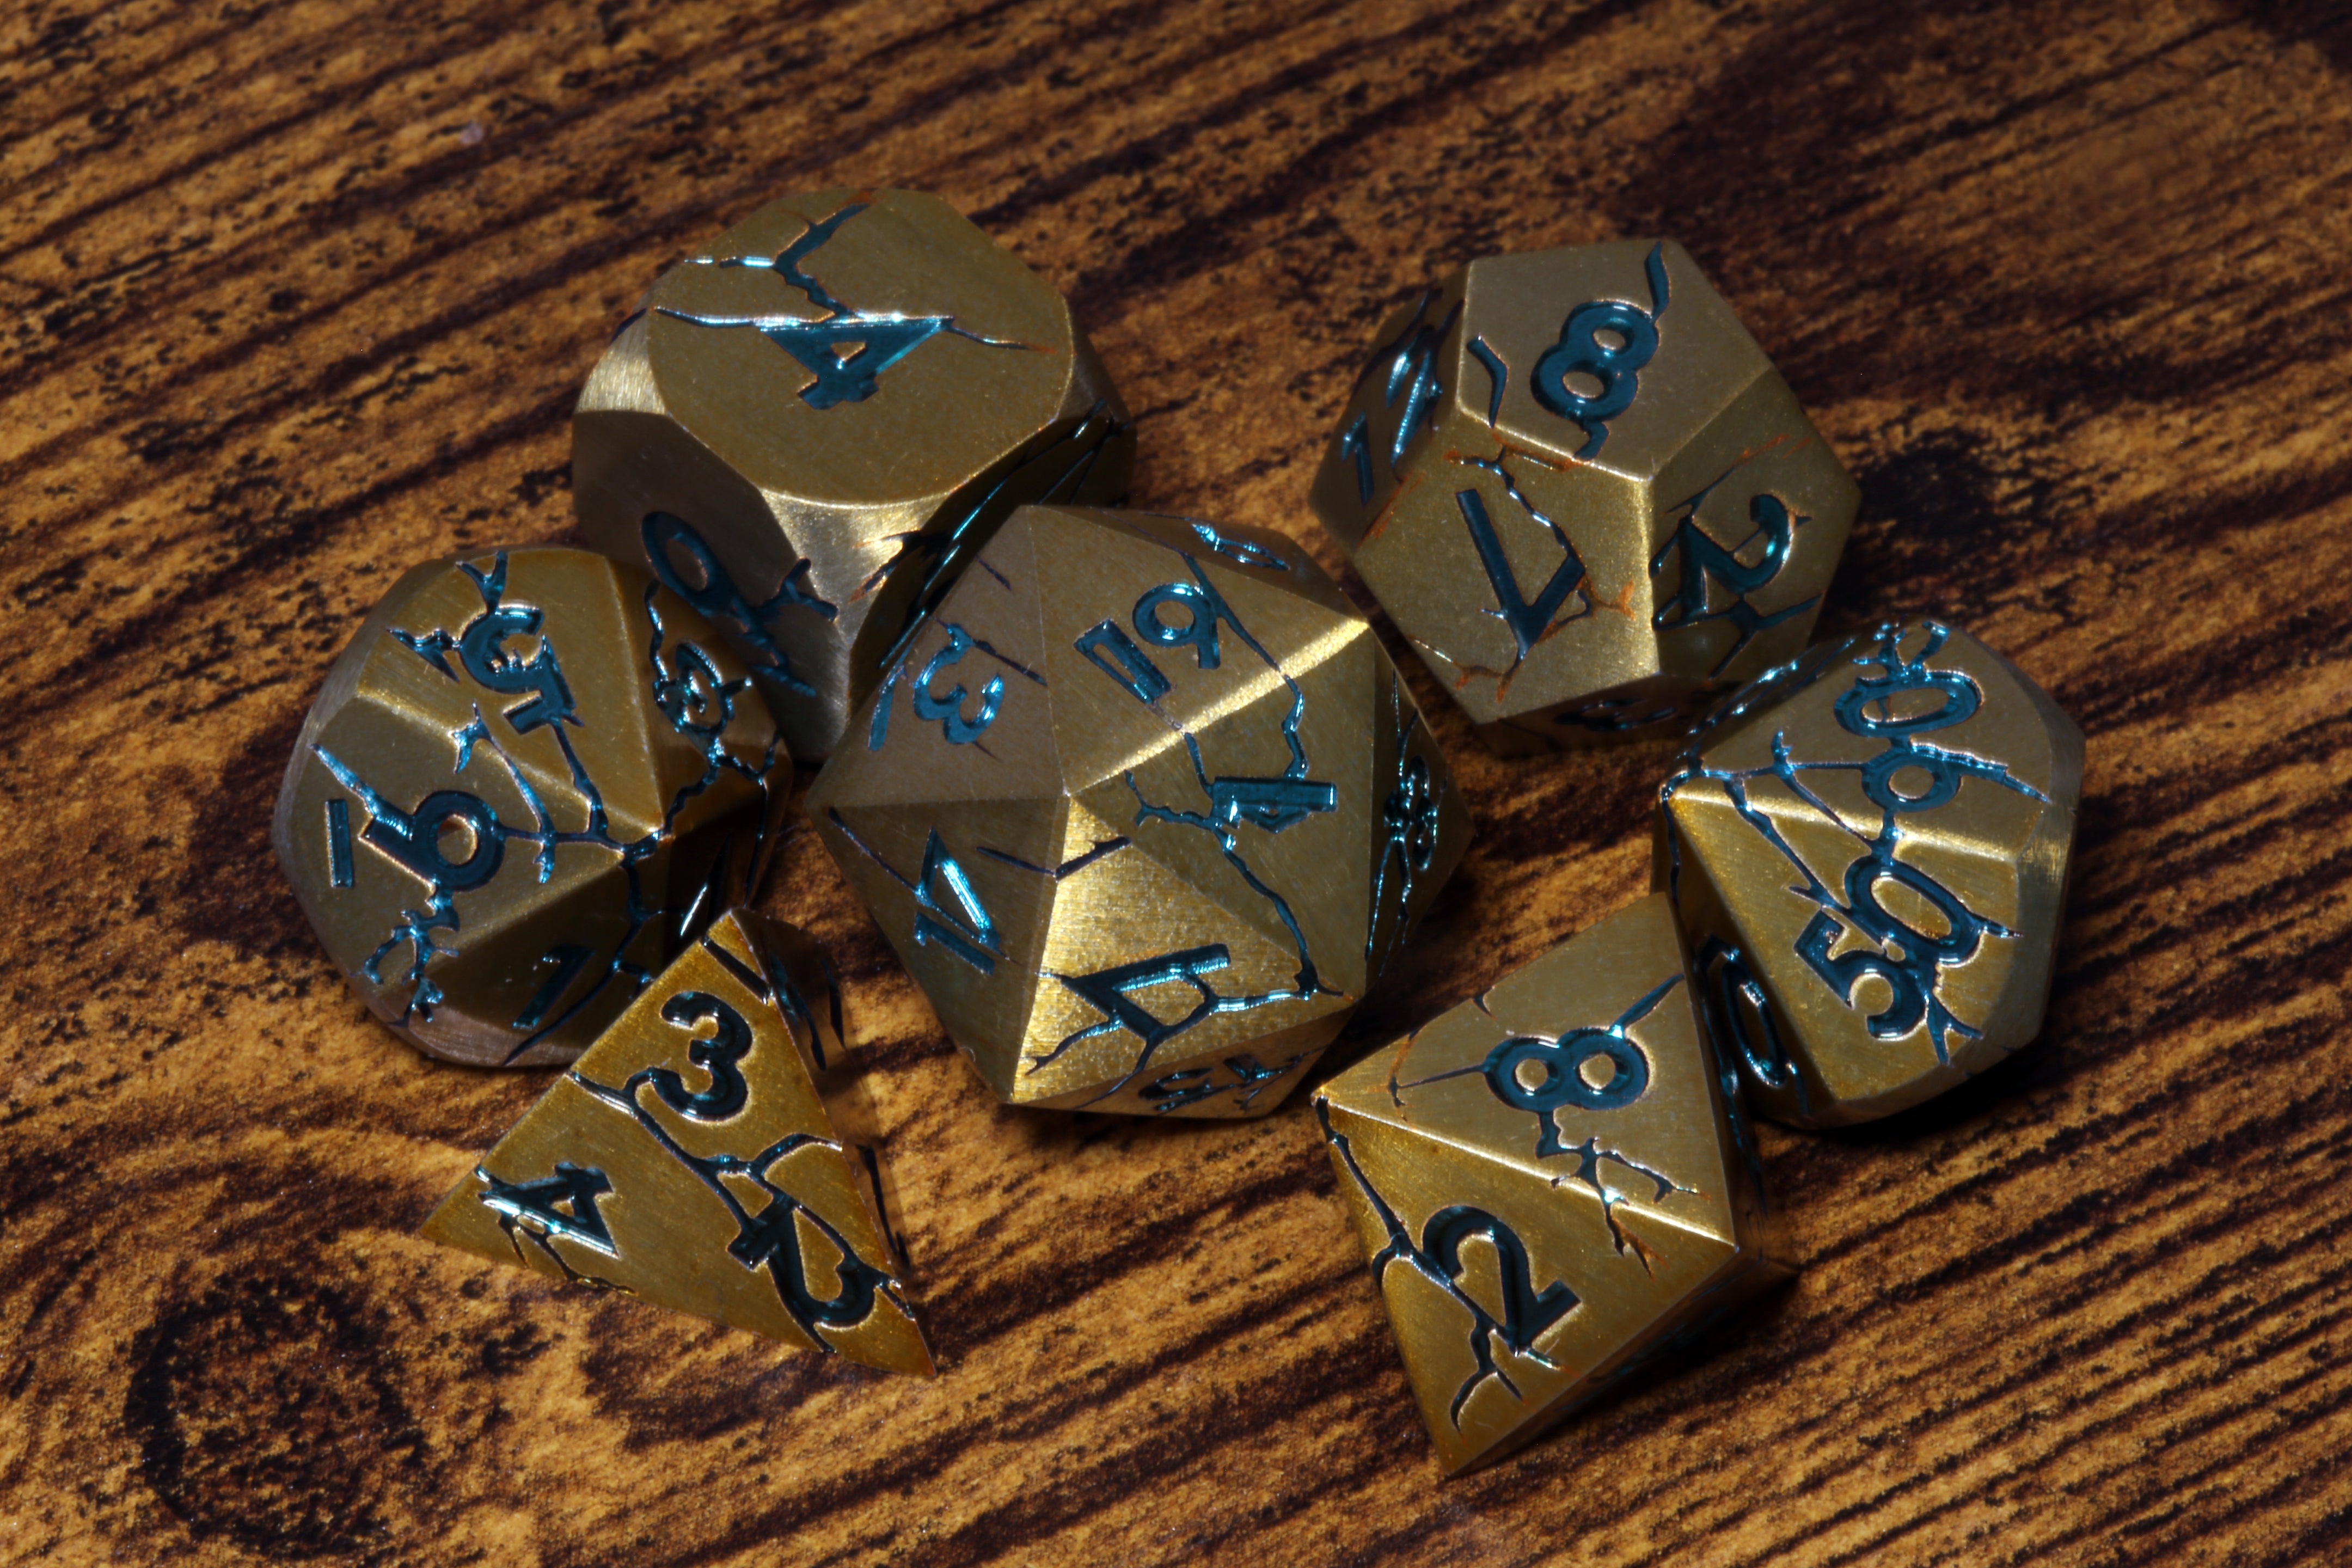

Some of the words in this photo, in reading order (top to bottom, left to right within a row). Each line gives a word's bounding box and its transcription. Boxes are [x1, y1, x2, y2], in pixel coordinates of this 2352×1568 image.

[759, 314, 953, 411] 4
[1530, 299, 1659, 421] 8
[1456, 488, 1585, 653] 7
[1679, 494, 1794, 615] 2
[459, 606, 576, 736] 5
[1074, 583, 1221, 705] 19
[1794, 856, 1987, 1039] 50
[653, 992, 752, 1122] 3
[1484, 1028, 1649, 1111] 8
[479, 1161, 620, 1258] 4
[727, 1195, 876, 1328] 2
[1423, 1205, 1581, 1355] 2
